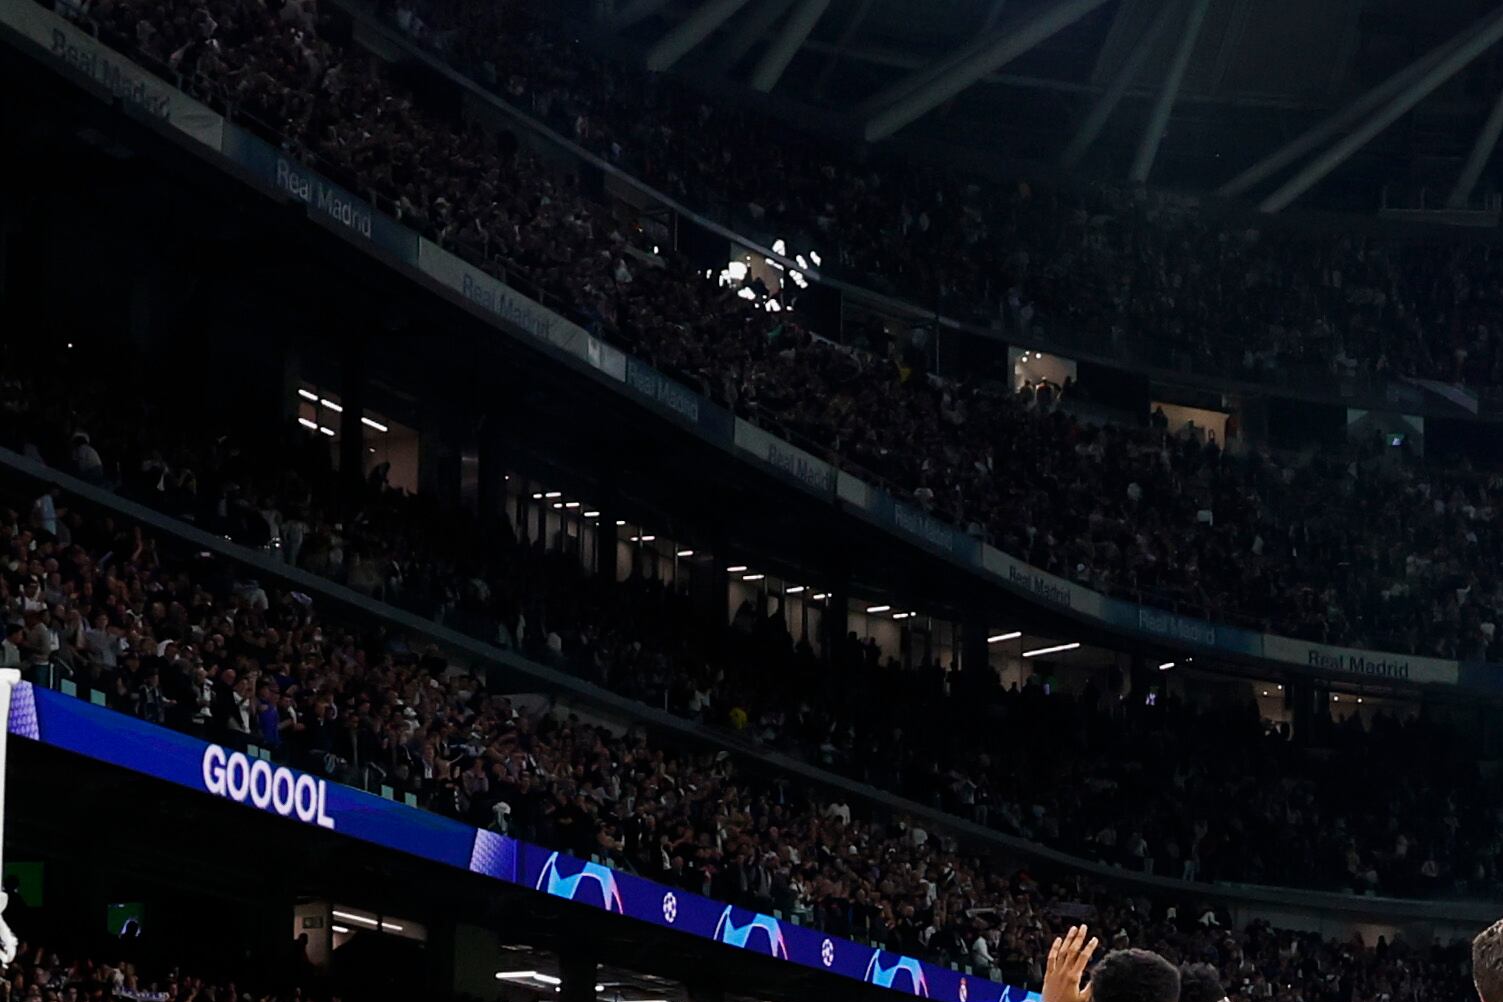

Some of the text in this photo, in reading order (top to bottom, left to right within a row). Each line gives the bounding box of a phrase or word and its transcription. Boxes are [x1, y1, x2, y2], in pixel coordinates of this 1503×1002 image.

[277, 158, 372, 239] Real Madrid
[1308, 650, 1409, 679] Real Madrid
[202, 743, 335, 830] GOOOOL
